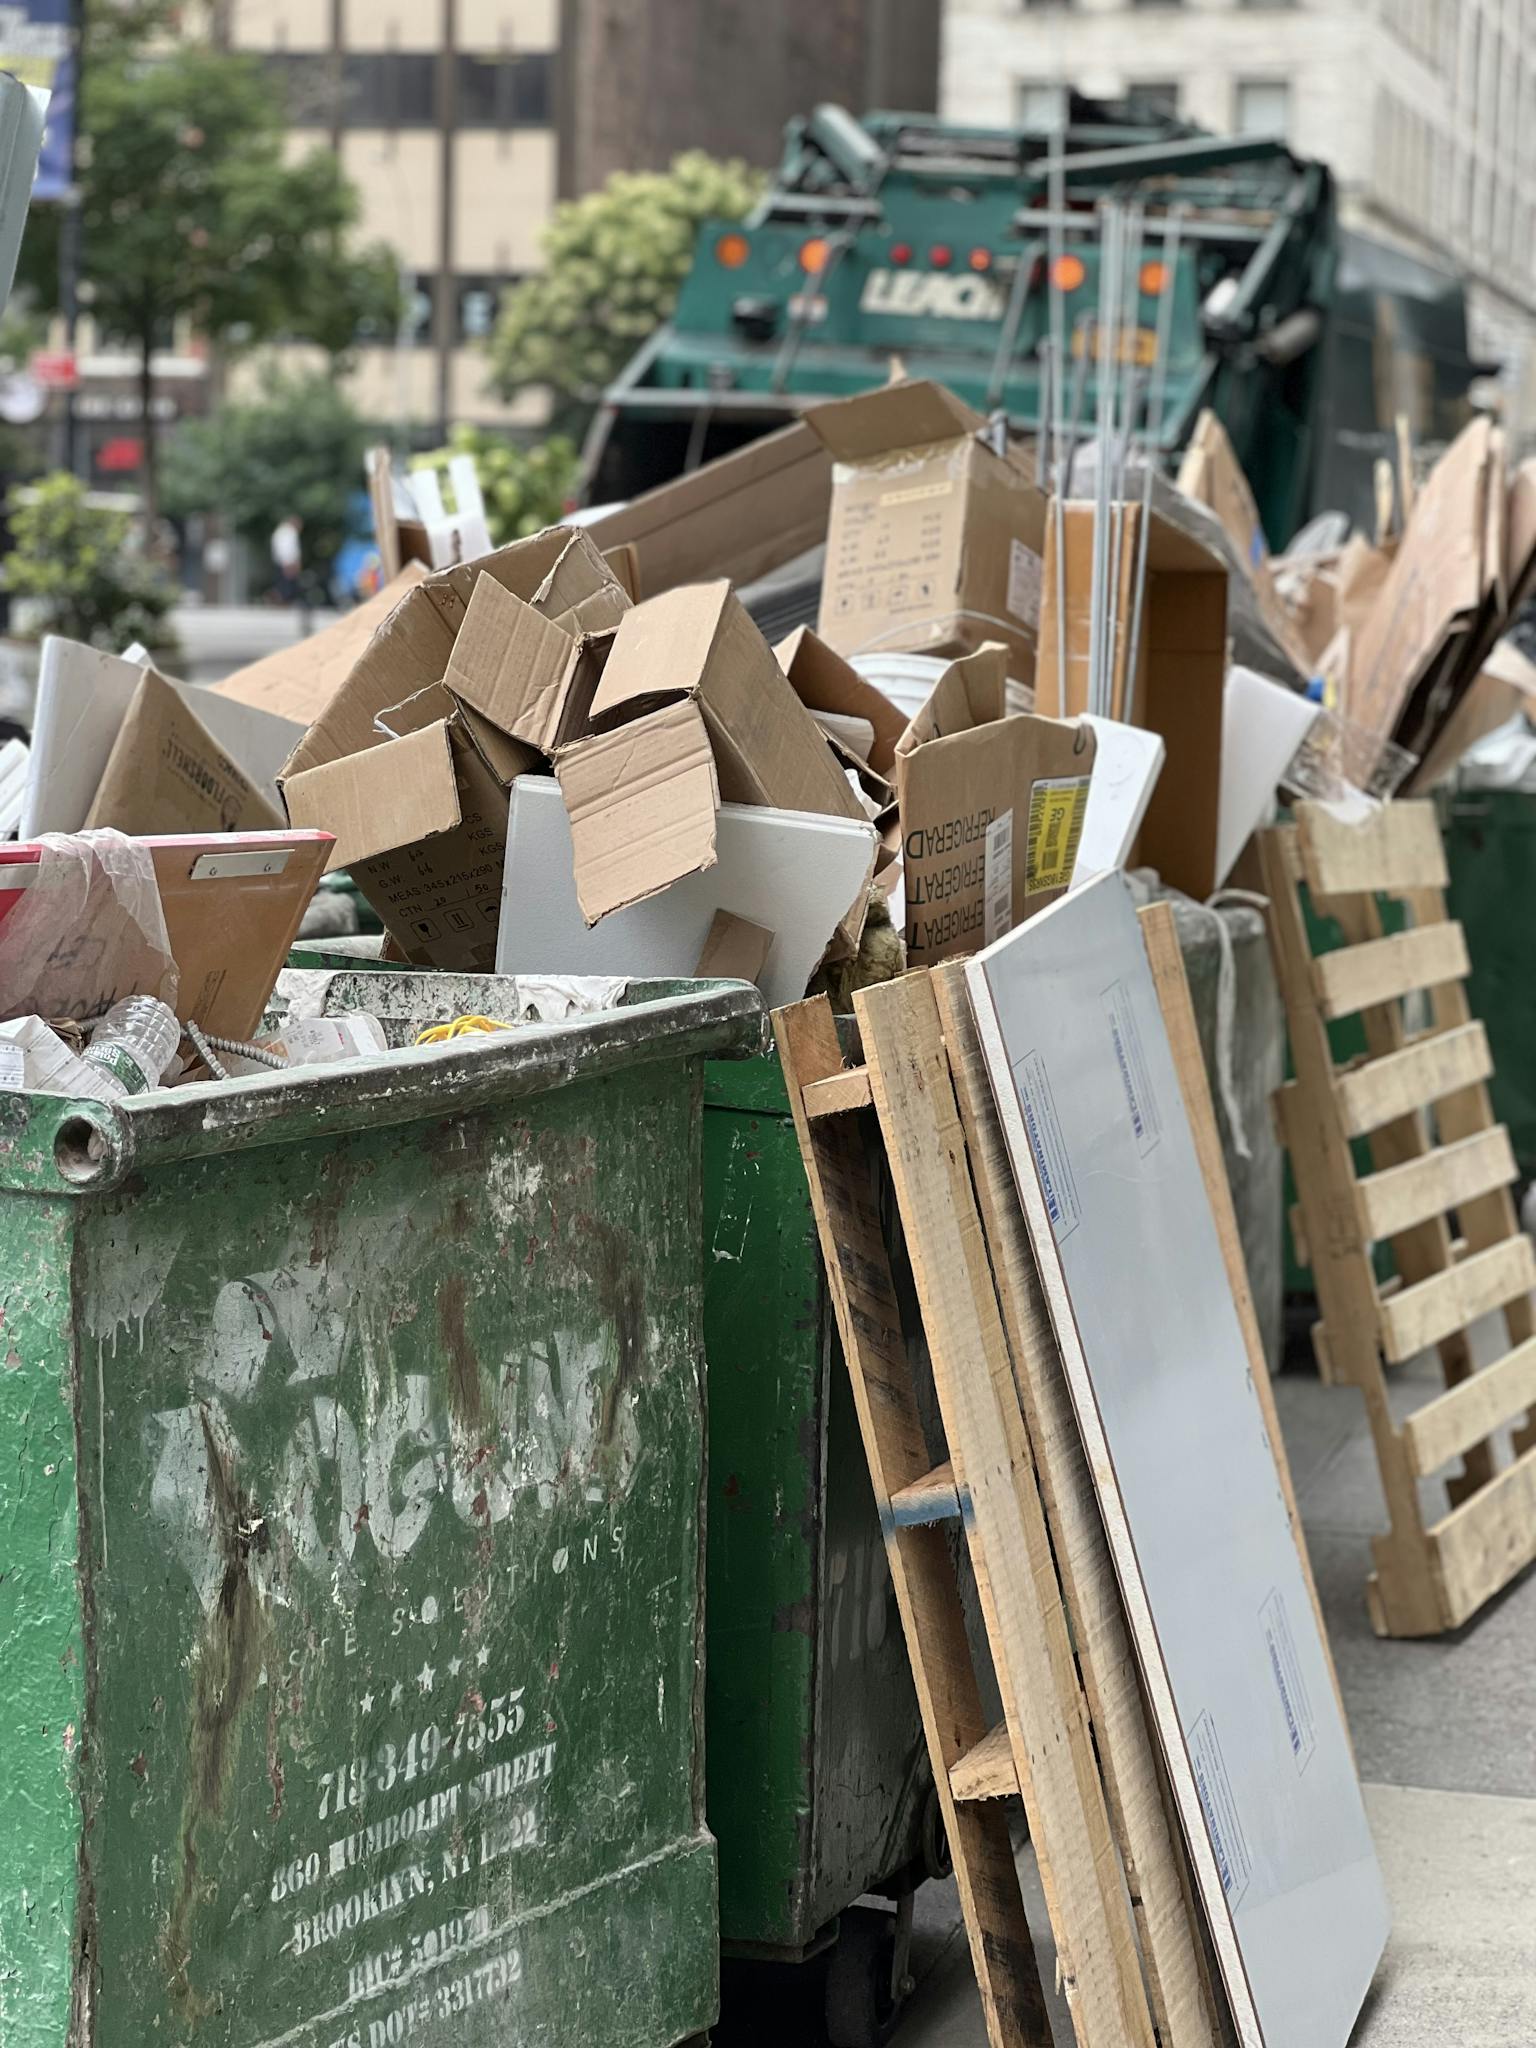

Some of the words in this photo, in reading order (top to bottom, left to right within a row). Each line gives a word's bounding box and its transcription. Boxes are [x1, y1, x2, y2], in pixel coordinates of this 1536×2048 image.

[464, 812, 482, 824] CS
[467, 827, 494, 841] KGS
[1051, 807, 1065, 821] GE
[907, 854, 986, 905] ÉFRIGÉRAT
[400, 904, 423, 918] CTN
[907, 899, 984, 950] EFRIGERAT
[317, 1686, 526, 1820] 718-349-7555
[271, 1852, 321, 1902] 860
[469, 1742, 557, 1805] STREET
[480, 1811, 539, 1865] 122
